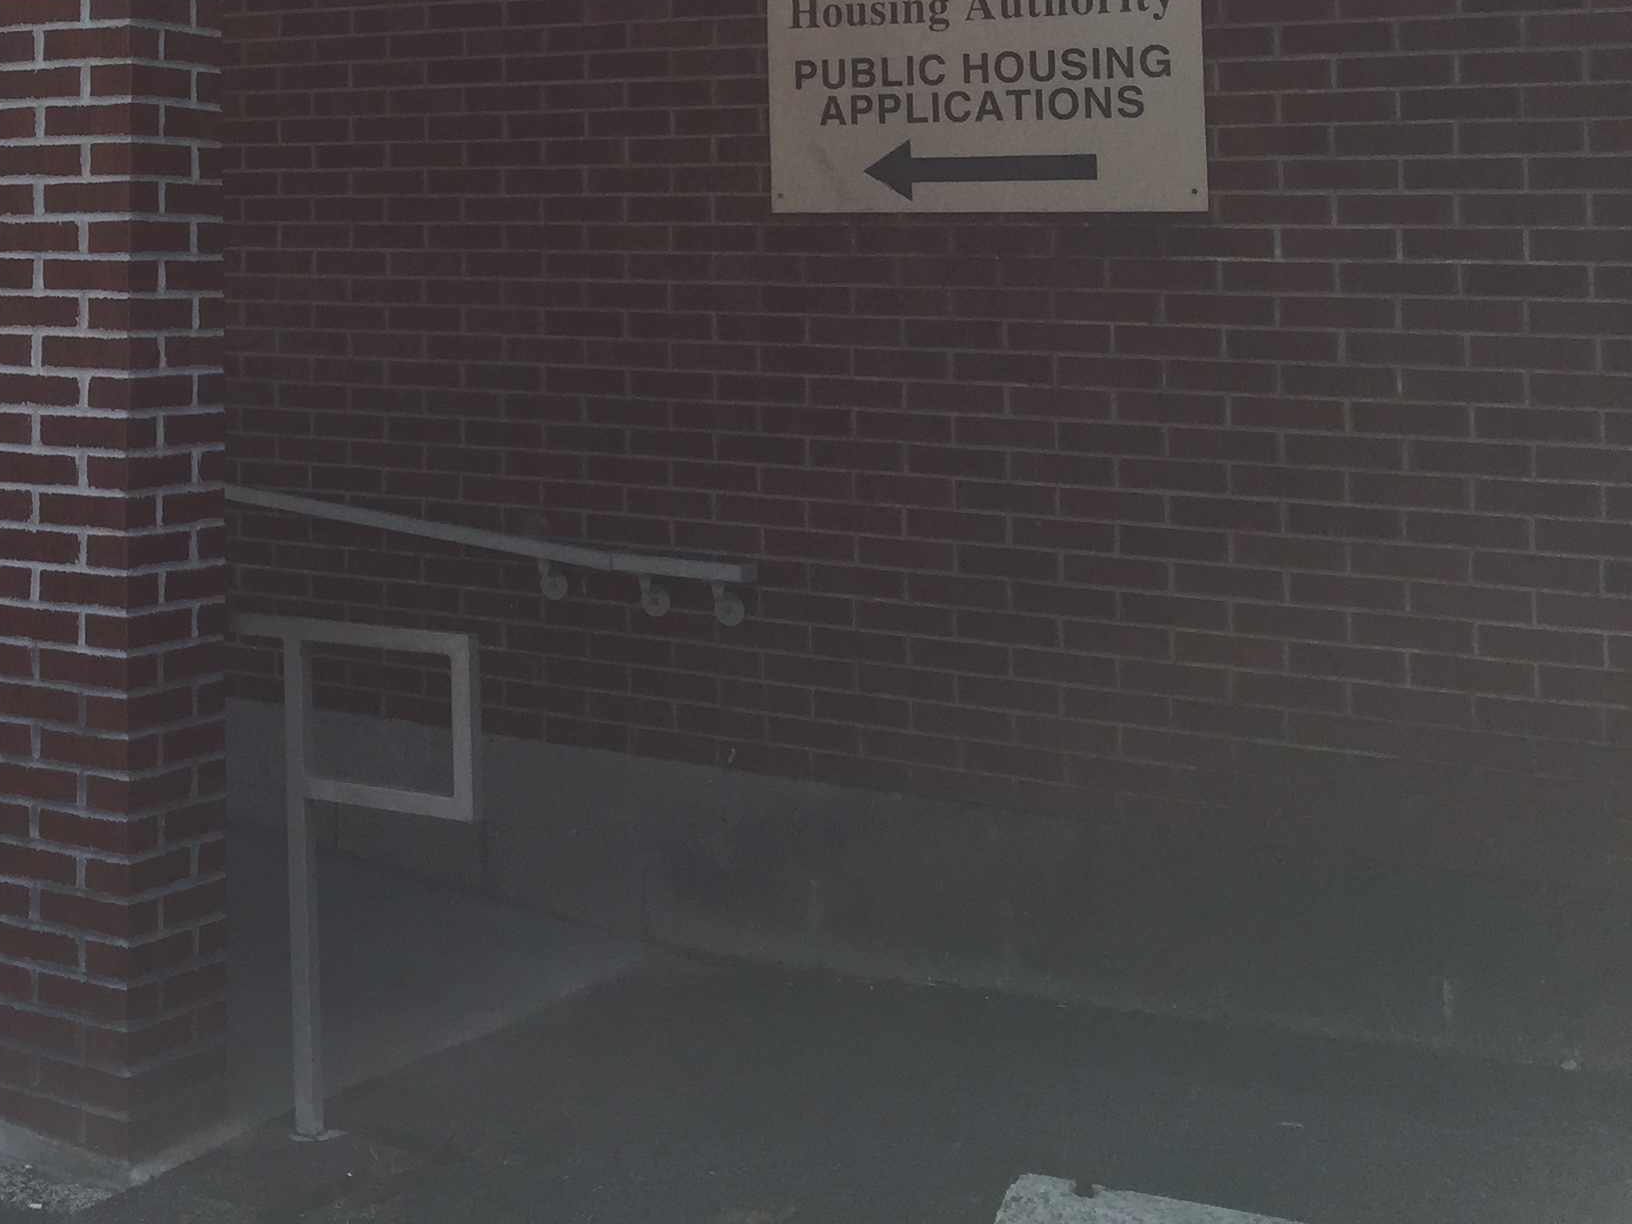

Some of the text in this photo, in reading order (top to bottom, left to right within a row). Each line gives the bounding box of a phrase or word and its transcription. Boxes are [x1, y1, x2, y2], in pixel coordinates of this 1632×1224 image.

[794, 44, 1172, 90] PUBLIC HOUSING
[819, 85, 1145, 126] APPLICATIONS
